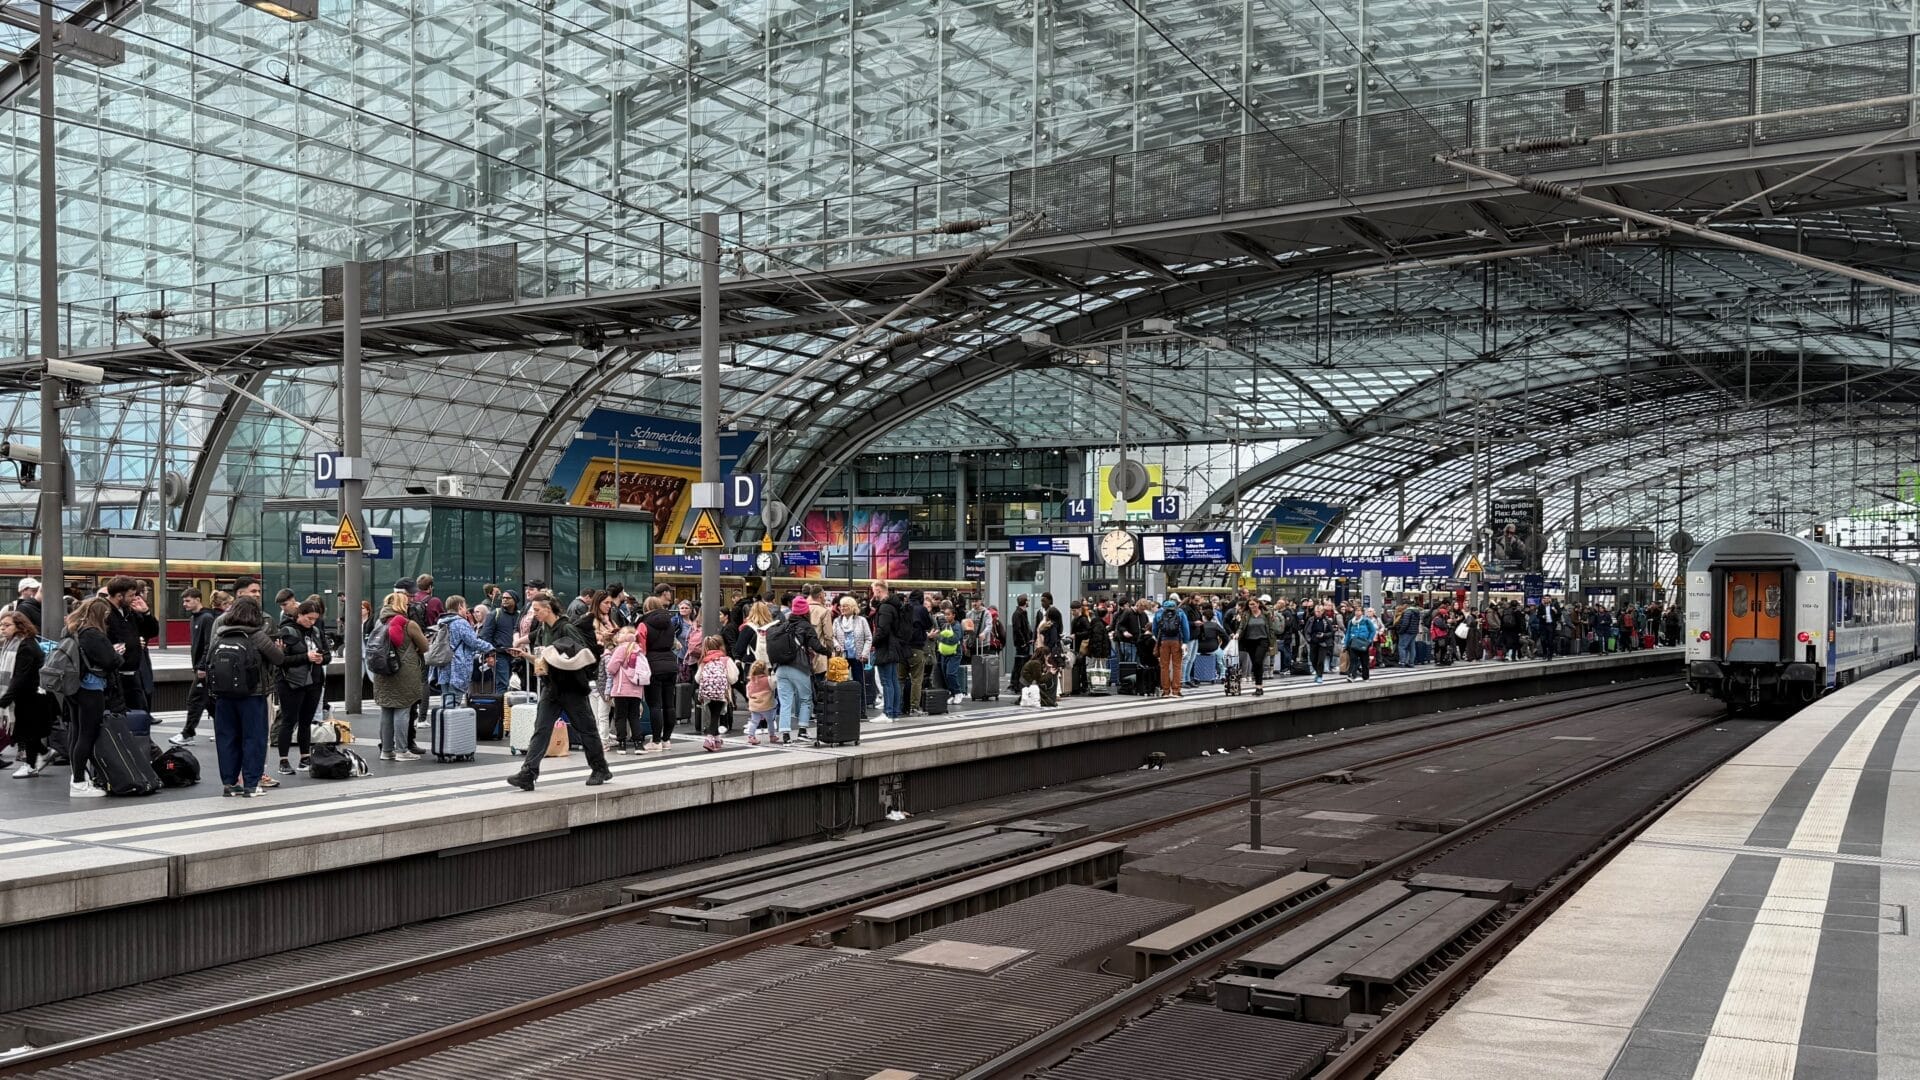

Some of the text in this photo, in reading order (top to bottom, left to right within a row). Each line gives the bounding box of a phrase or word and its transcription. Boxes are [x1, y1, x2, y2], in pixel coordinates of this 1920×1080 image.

[317, 453, 333, 481] D
[605, 474, 680, 489] NSSKLASSE
[734, 476, 754, 507] D
[1068, 500, 1087, 517] 14
[1157, 496, 1176, 514] 13
[790, 525, 802, 537] 15
[305, 535, 327, 545] Berlin
[1587, 546, 1596, 558] E
